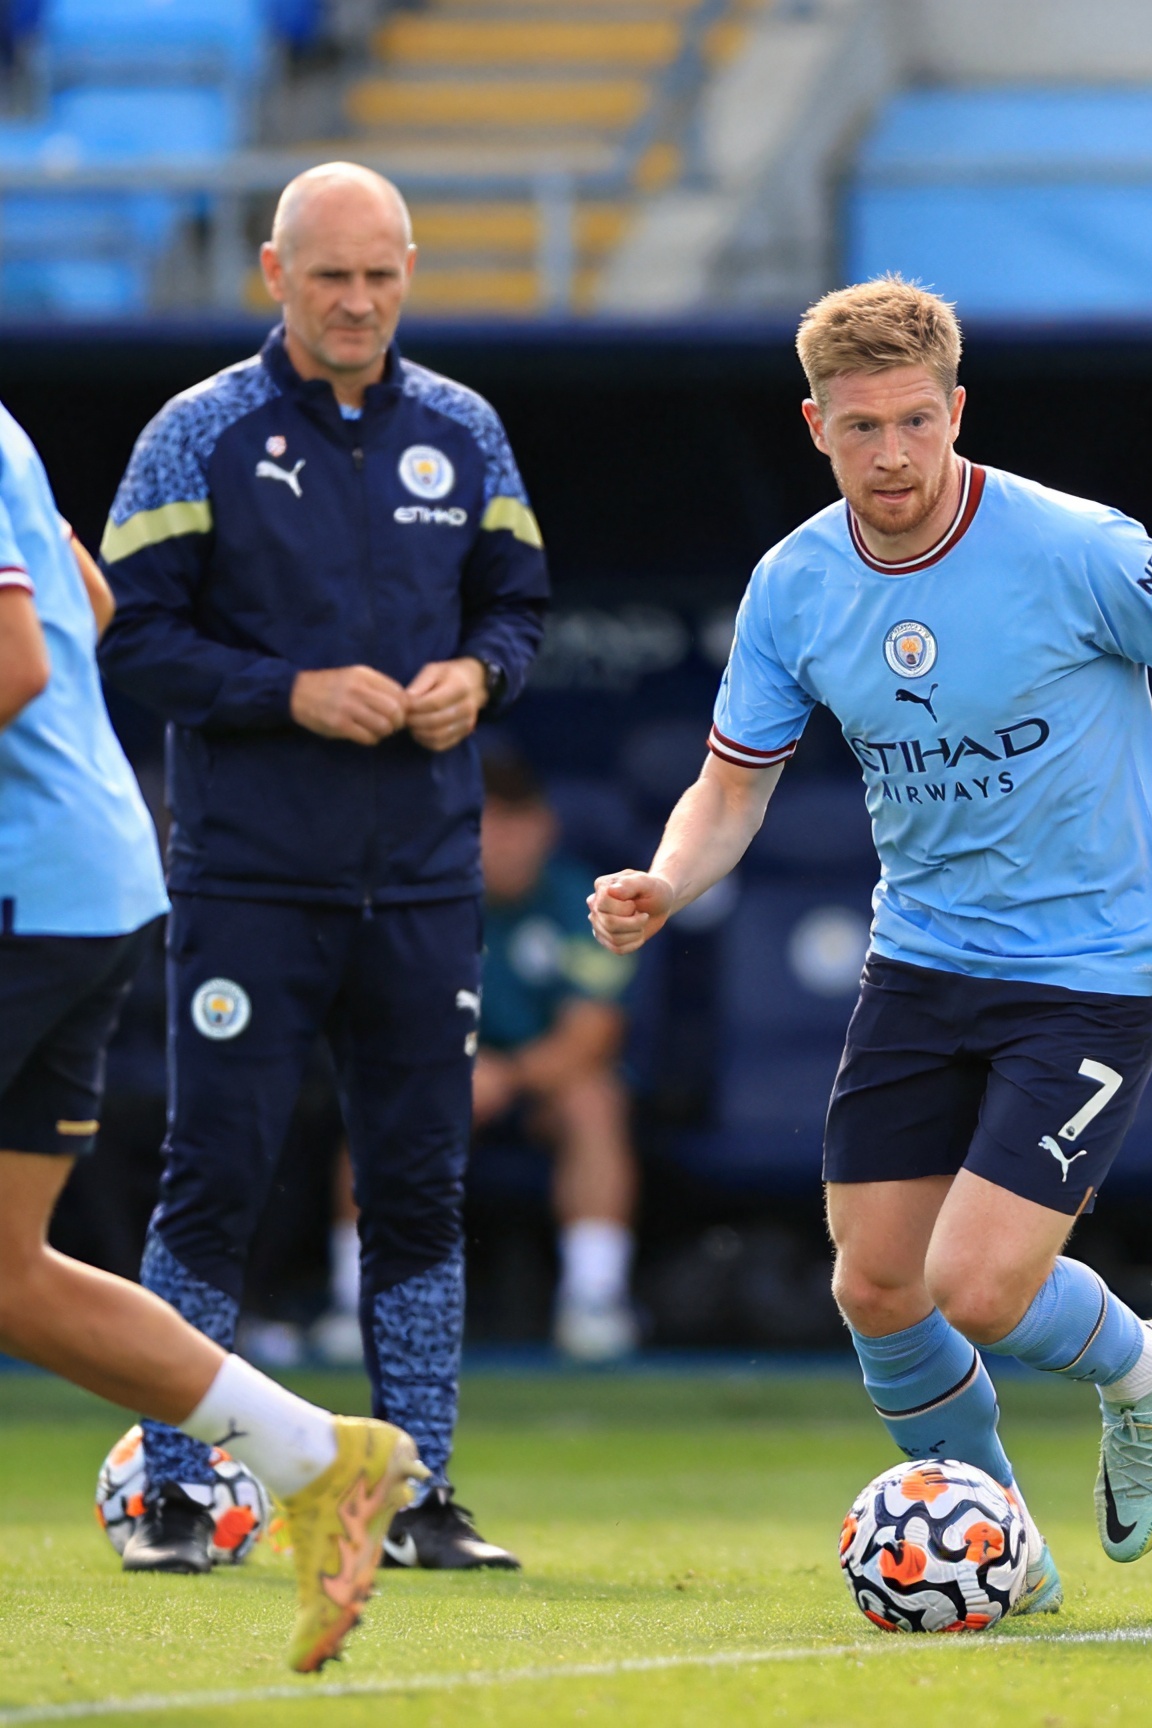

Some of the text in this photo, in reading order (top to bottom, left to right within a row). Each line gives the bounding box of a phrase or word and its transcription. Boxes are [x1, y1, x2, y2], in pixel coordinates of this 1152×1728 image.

[851, 717, 1050, 775] ETIHAD
[882, 771, 1014, 805] AIRWAYS
[1058, 1058, 1123, 1141] 7
